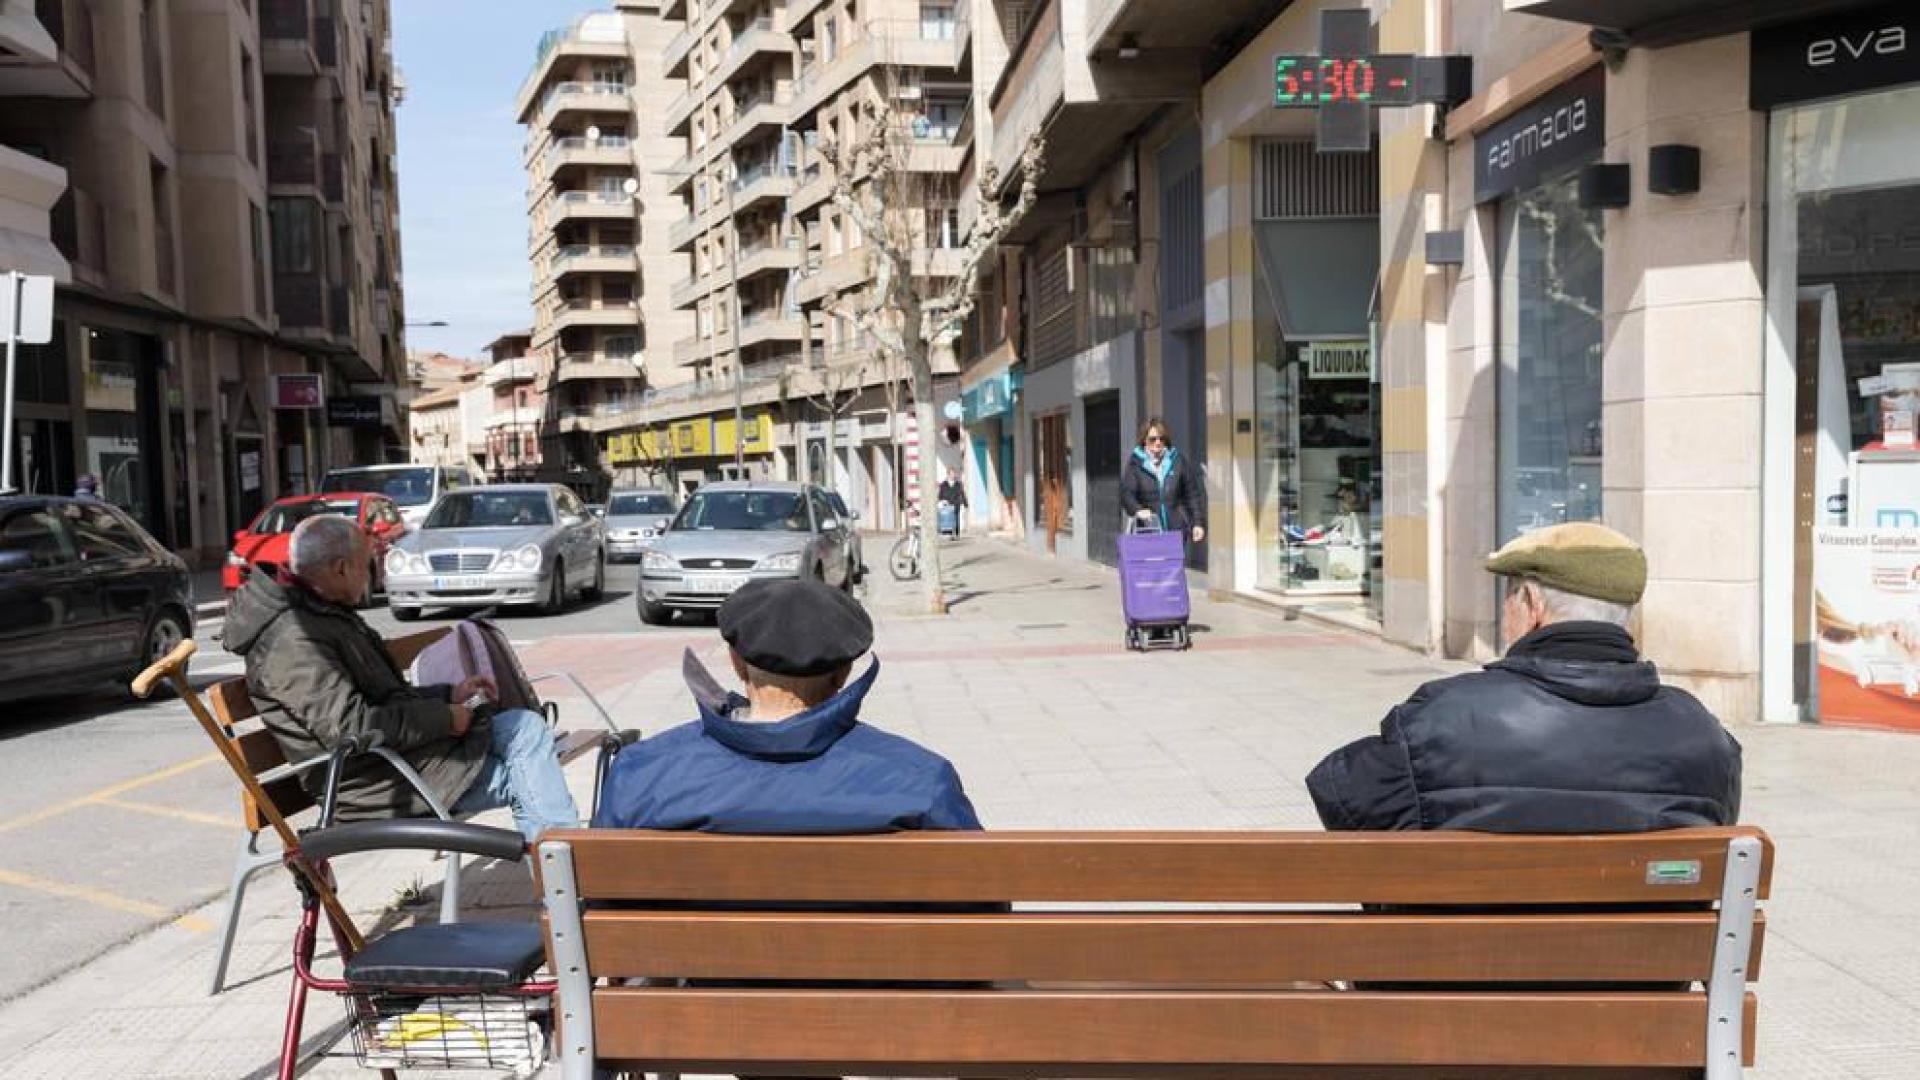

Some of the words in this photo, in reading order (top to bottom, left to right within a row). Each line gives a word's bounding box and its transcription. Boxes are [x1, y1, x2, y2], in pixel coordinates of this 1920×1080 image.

[1807, 26, 1905, 66] eva
[1487, 98, 1586, 175] farmacia
[1312, 348, 1370, 373] LIQUIDAC
